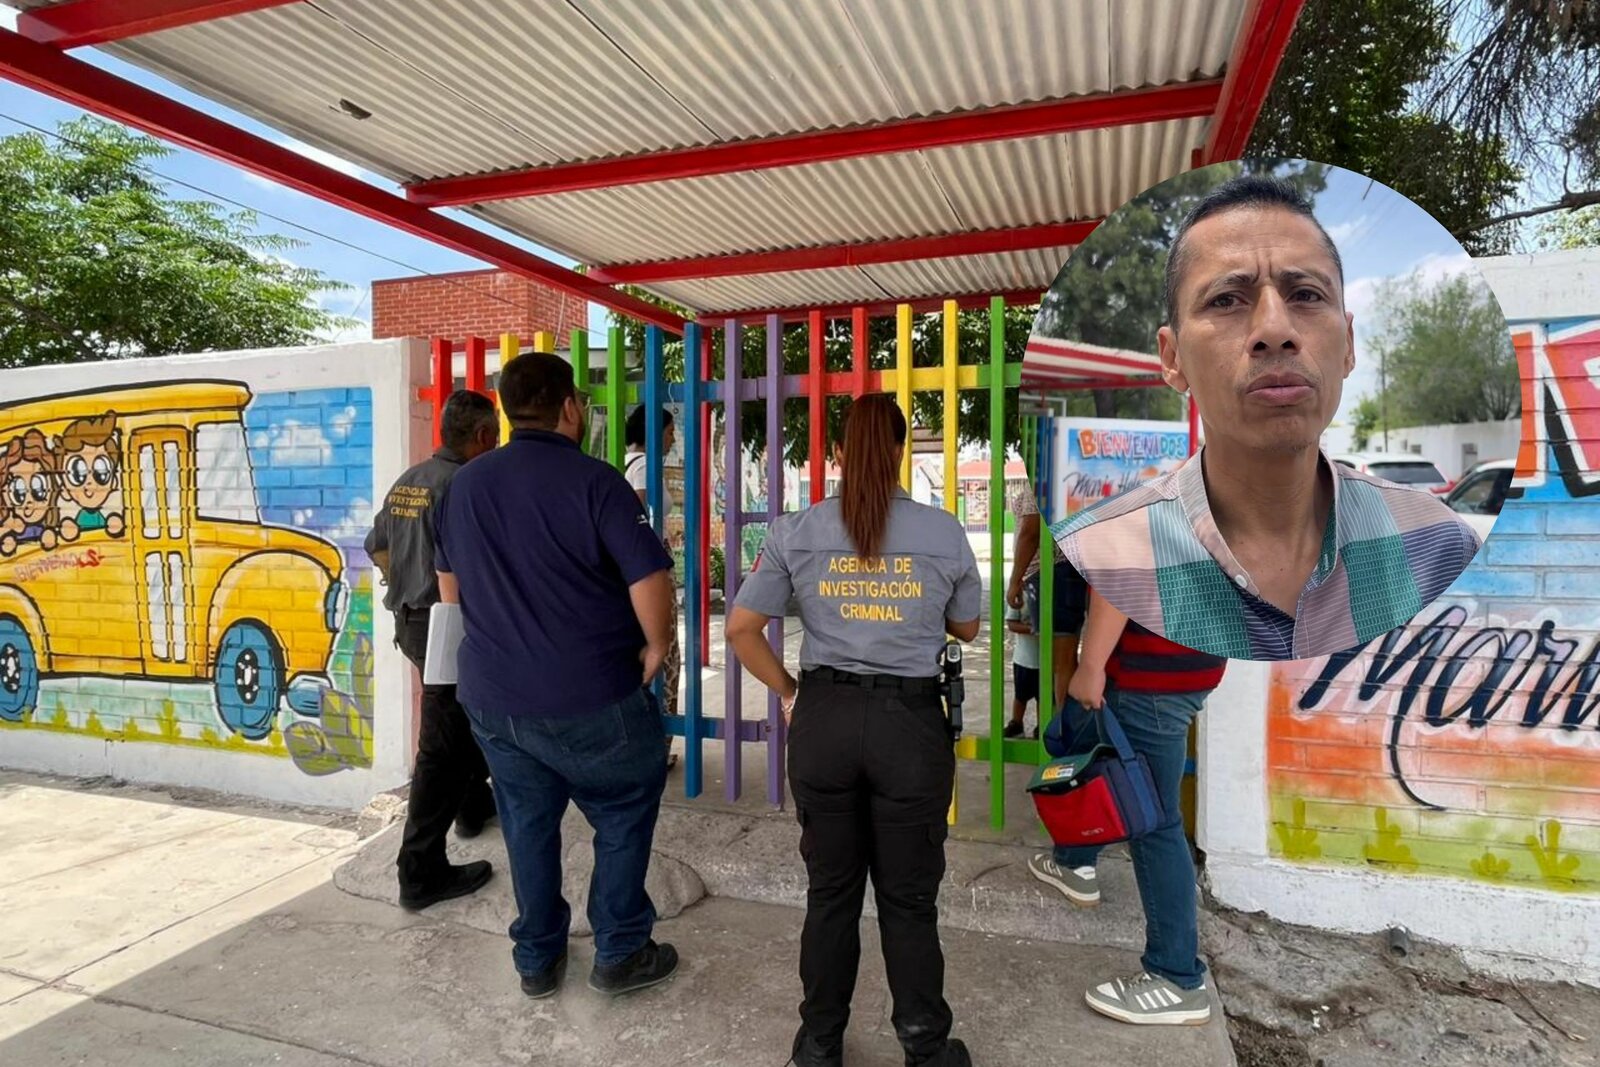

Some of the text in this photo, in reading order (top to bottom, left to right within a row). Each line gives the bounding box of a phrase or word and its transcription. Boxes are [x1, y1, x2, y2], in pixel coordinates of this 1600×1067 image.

[1079, 429, 1187, 459] BIENVENIDOS
[828, 557, 912, 574] AGENCIA DE
[819, 575, 921, 598] INVESTIGACIÓN
[840, 602, 903, 622] CRIMINAL
